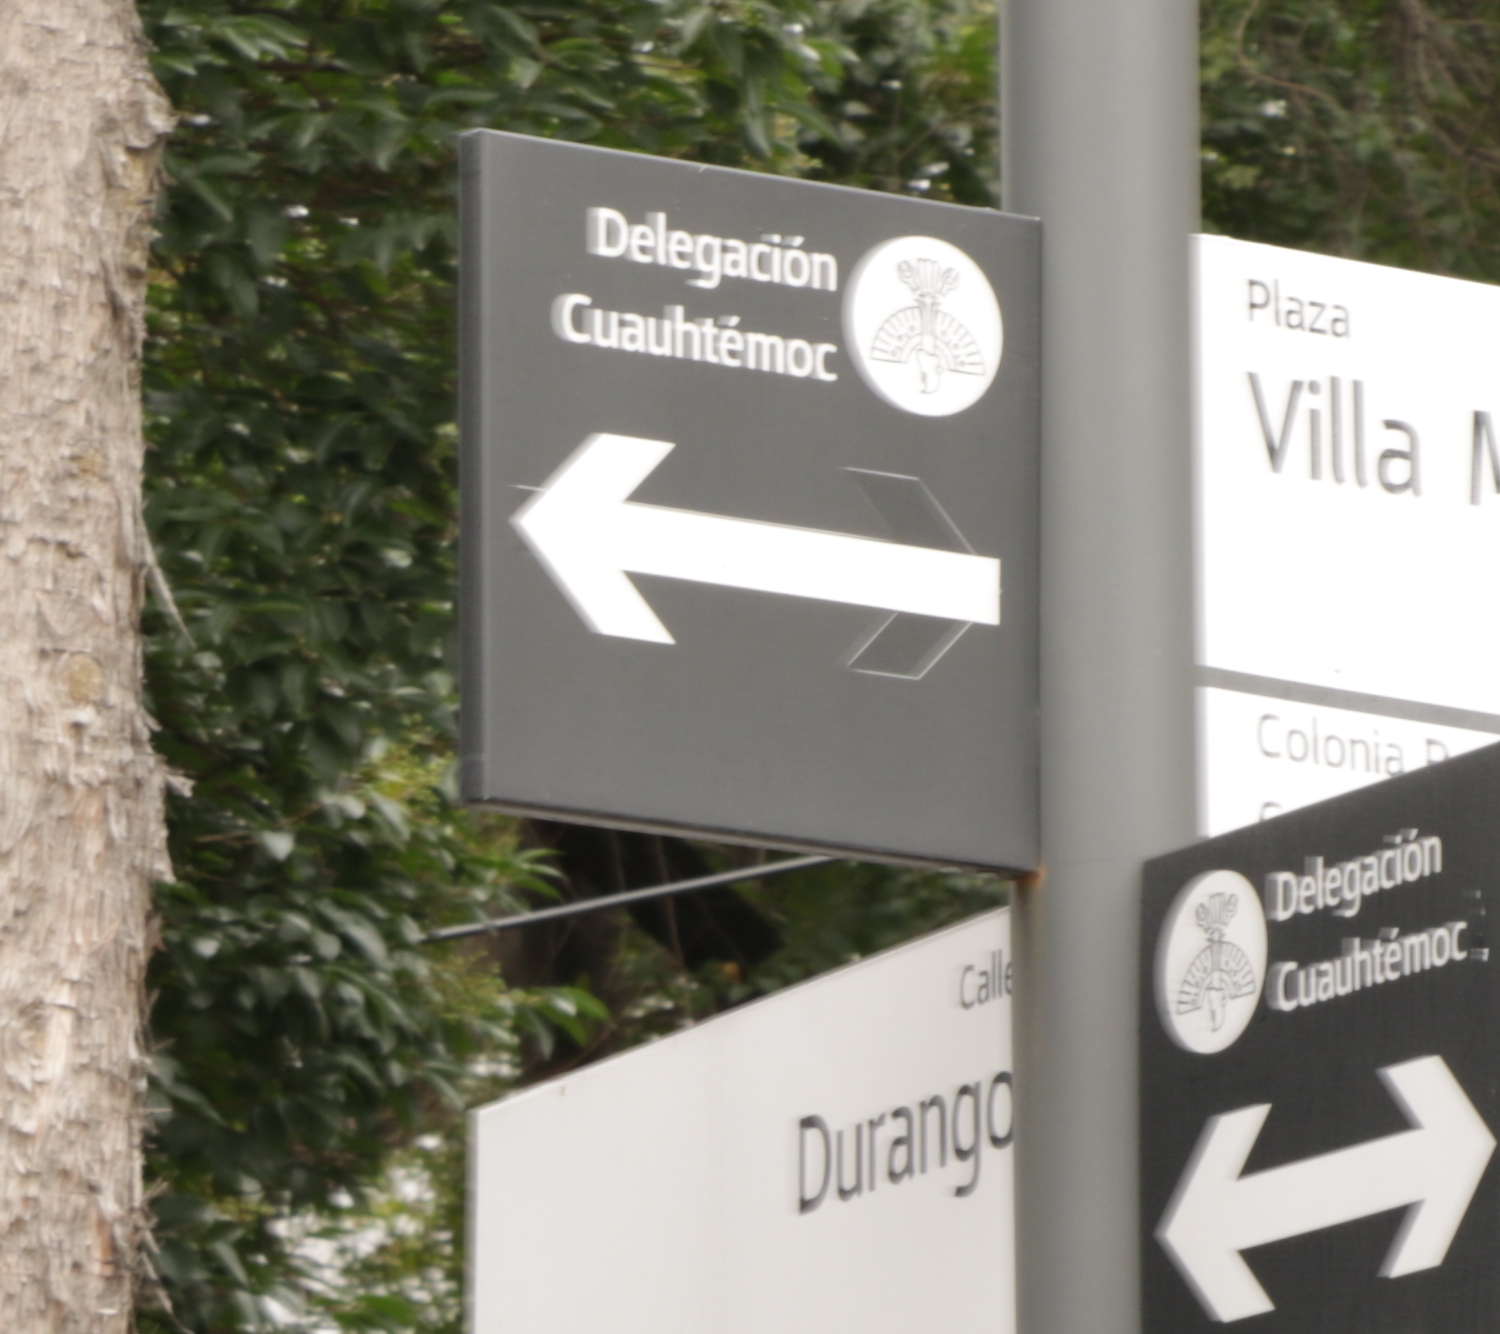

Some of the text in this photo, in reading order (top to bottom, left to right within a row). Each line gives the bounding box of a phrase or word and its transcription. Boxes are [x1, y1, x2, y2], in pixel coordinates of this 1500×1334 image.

[588, 207, 838, 290] Delegación
[552, 293, 838, 381] Cuauhtémoc
[1247, 277, 1350, 339] Plaza
[1247, 371, 1422, 497] Villa
[1257, 713, 1405, 777] Colonia
[1266, 829, 1442, 921] Delegación
[1267, 922, 1467, 1012] Cuauhtémoc
[799, 1070, 1013, 1216] Durango
